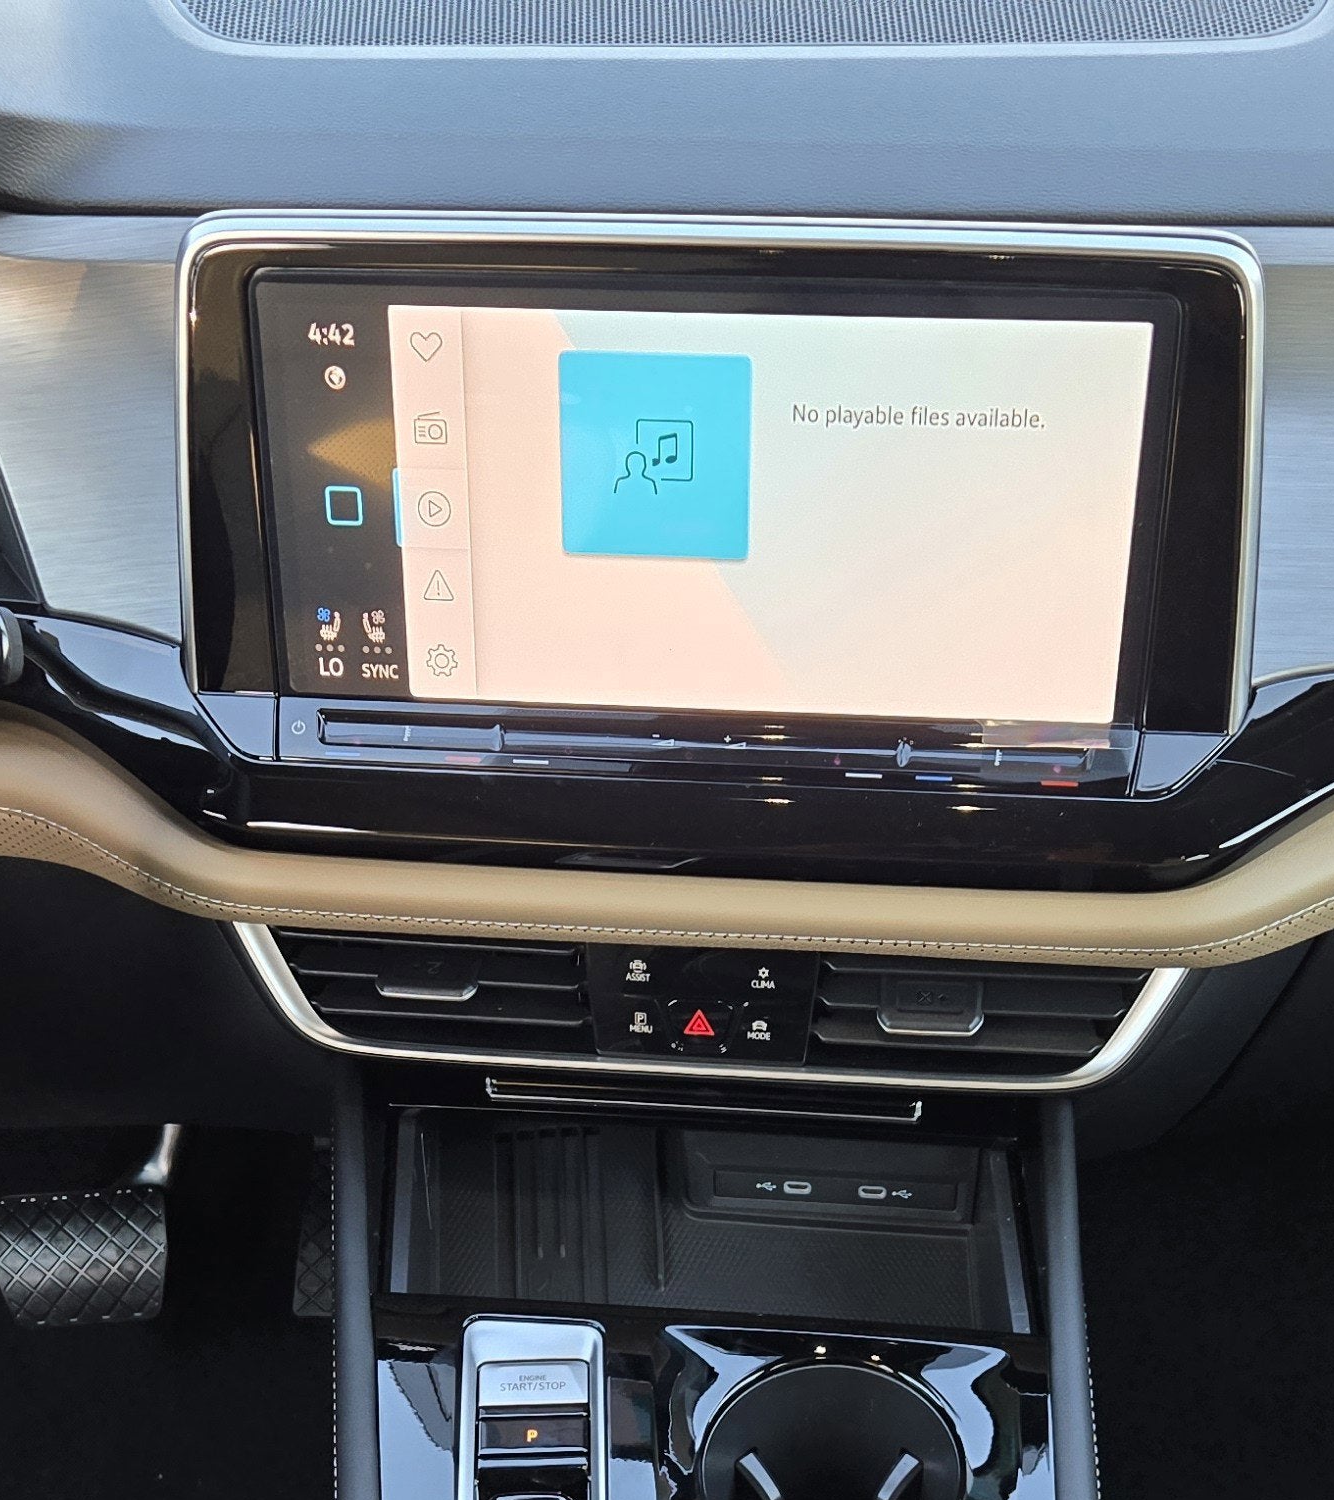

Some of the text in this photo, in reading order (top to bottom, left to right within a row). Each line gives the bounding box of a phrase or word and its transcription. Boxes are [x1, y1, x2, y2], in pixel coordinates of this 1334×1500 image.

[307, 322, 355, 346] 4:42
[792, 403, 1046, 430] No playable files available.
[318, 656, 345, 677] LO
[361, 663, 399, 680] SYNC
[625, 972, 651, 983] ASSIST
[750, 979, 776, 990] CLIMA
[629, 1023, 653, 1034] MENU
[746, 1031, 771, 1042] MODE
[518, 1374, 547, 1382] ENGINE
[499, 1381, 566, 1392] START/STOP
[526, 1429, 538, 1443] P
